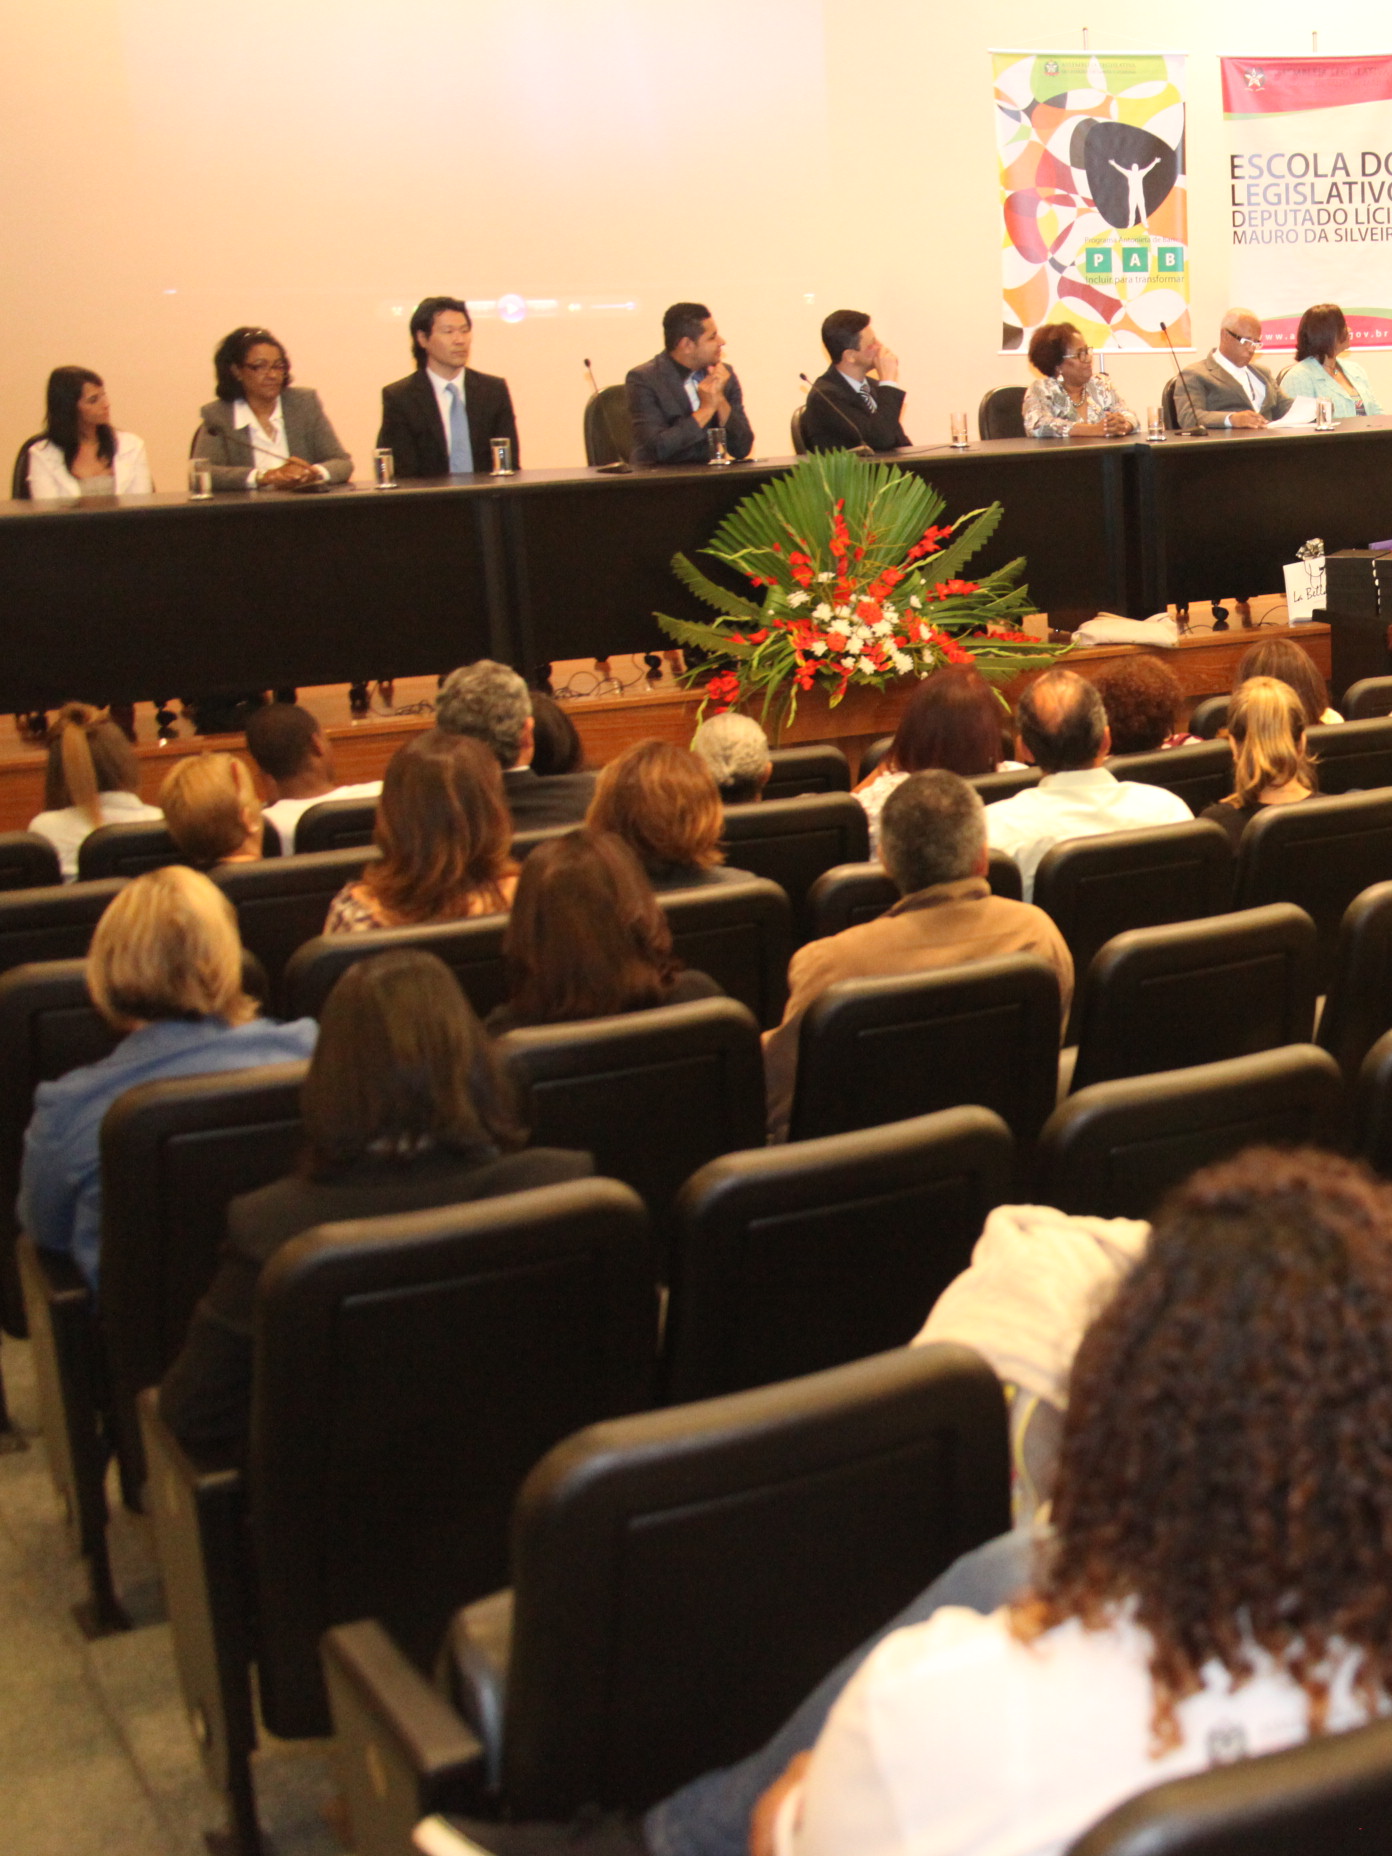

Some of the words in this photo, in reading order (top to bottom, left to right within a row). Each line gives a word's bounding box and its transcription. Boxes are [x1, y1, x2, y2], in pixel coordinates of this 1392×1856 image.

[1230, 152, 1351, 180] ESCOLA
[1232, 207, 1348, 228] DEPUTADO
[1233, 228, 1299, 245] MAURO
[1304, 228, 1329, 244] DA
[1085, 275, 1112, 283] Incluir
[1114, 276, 1133, 285] para
[1135, 275, 1185, 284] transformar
